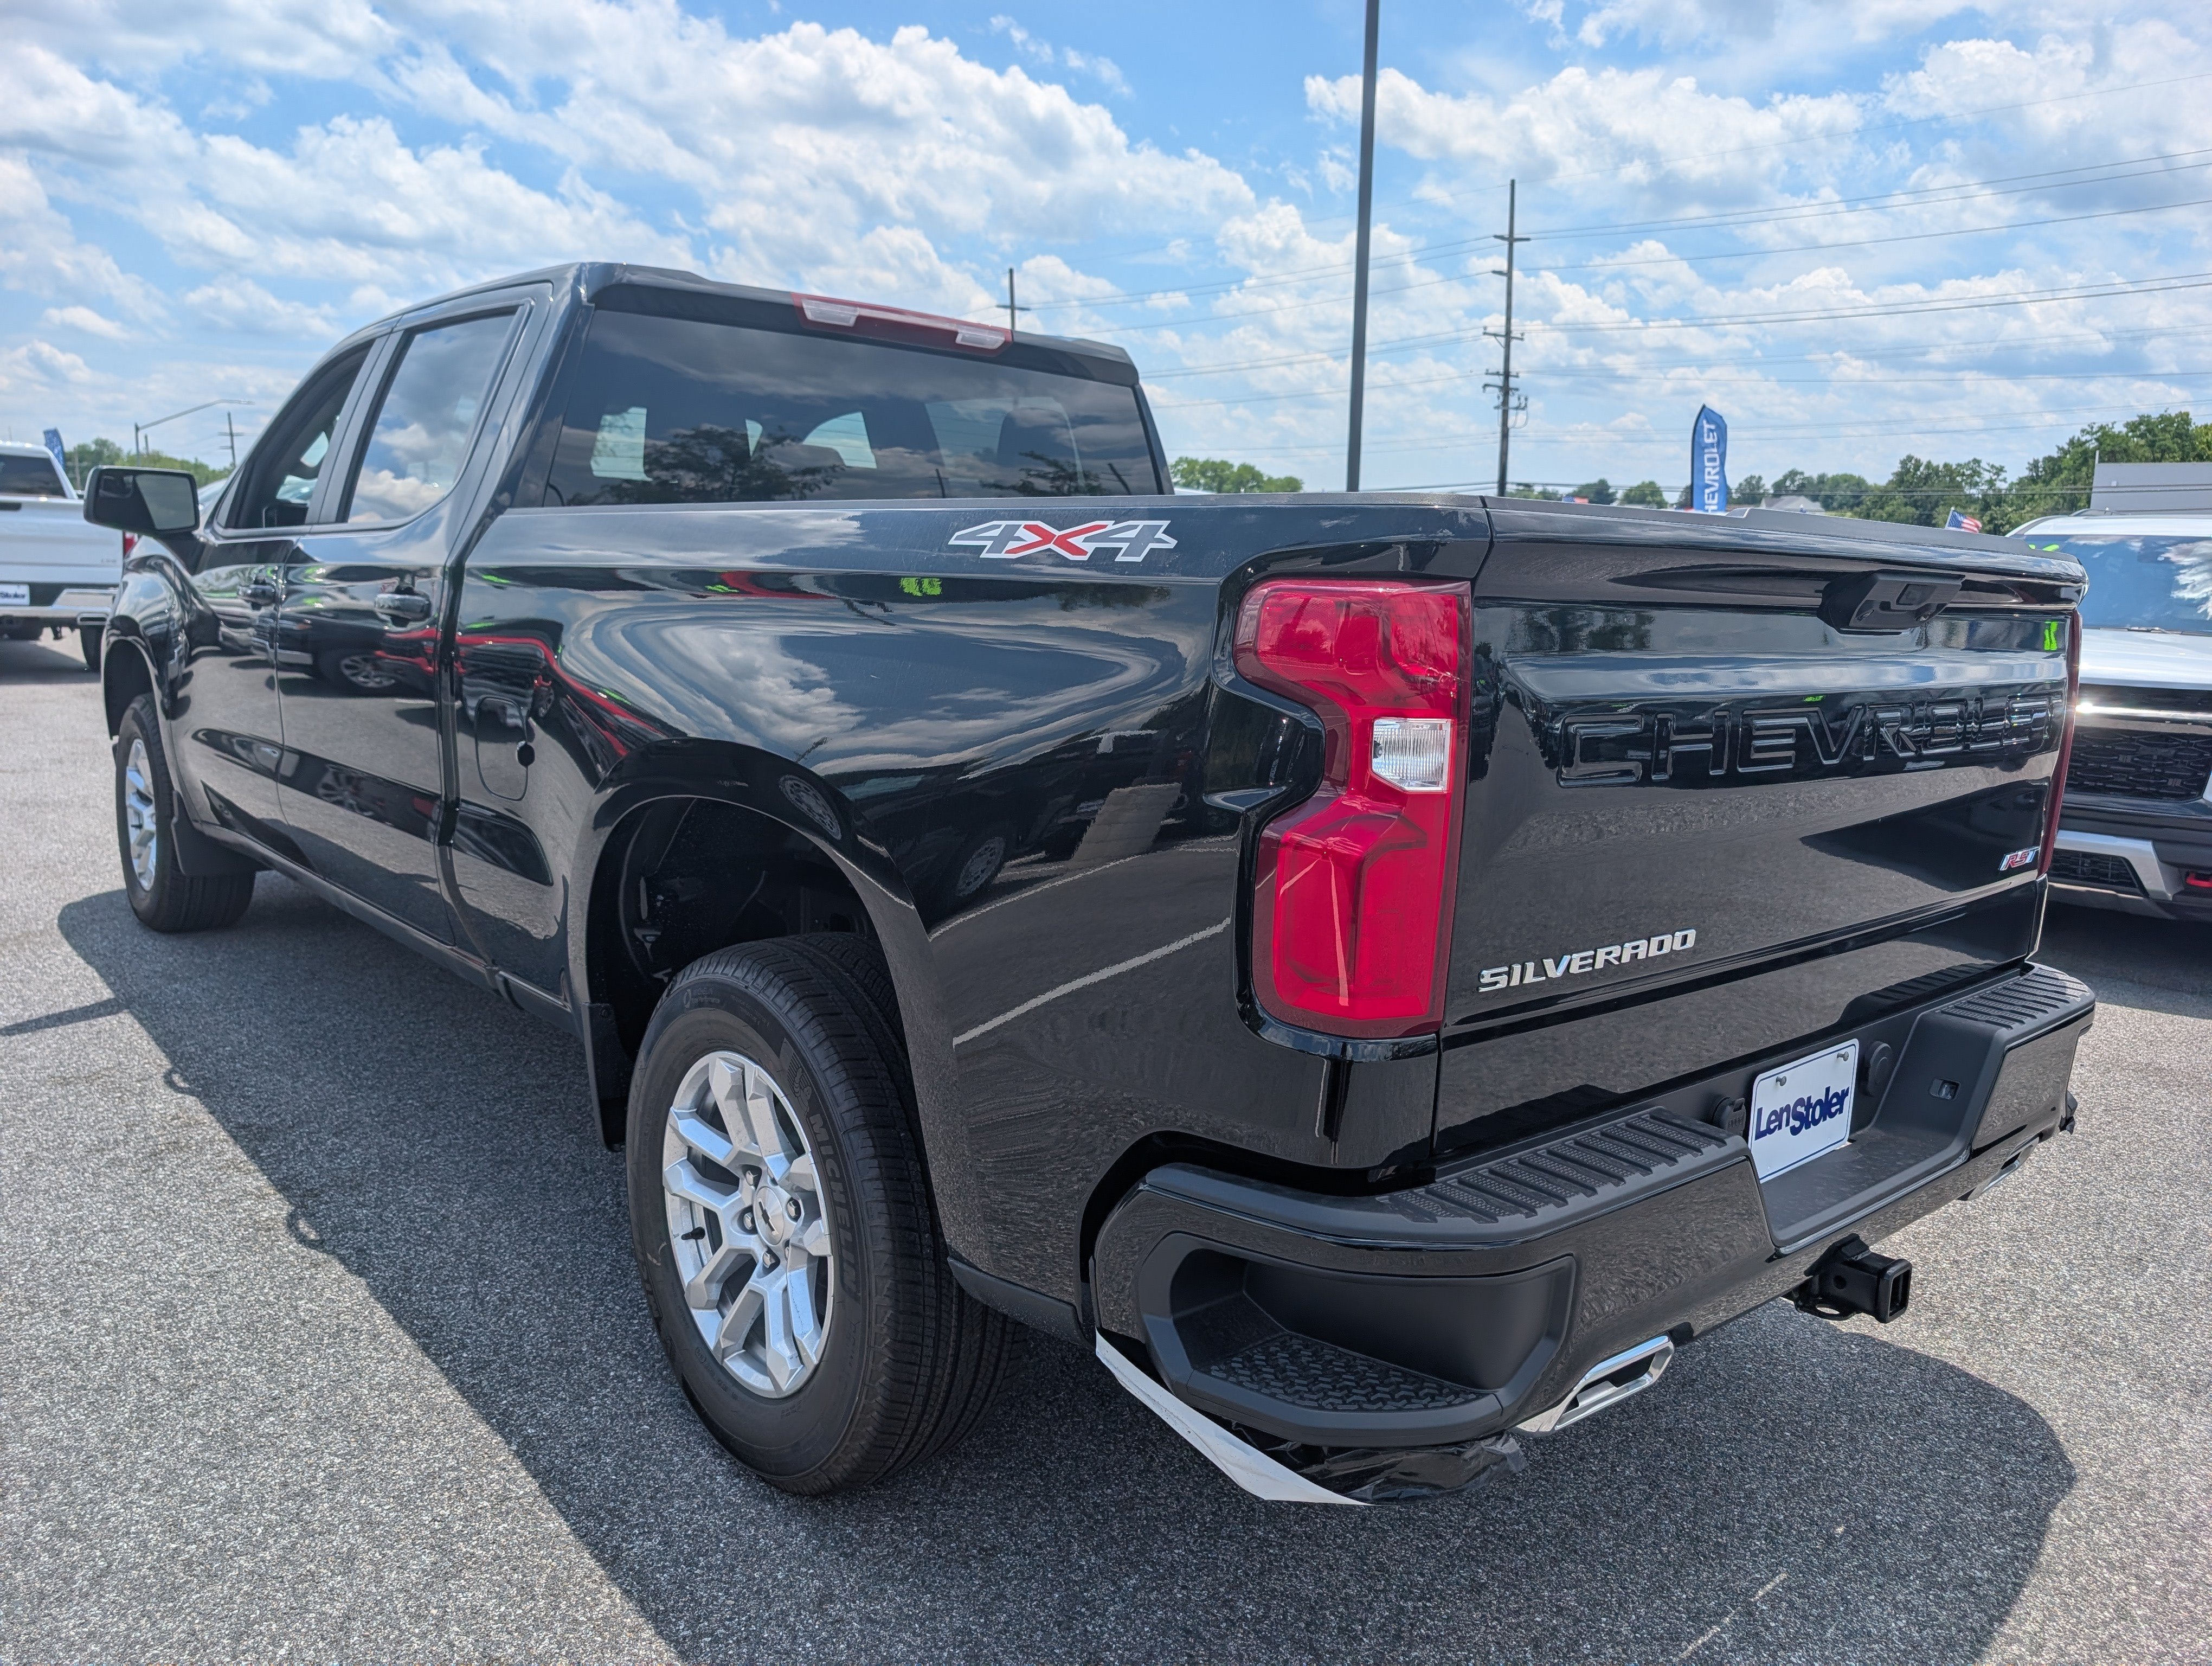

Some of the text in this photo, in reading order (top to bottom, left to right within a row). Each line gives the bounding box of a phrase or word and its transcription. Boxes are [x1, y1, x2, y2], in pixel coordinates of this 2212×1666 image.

[948, 521, 1178, 562] 4X4
[1477, 928, 1696, 992] SILVERADO
[809, 1113, 861, 1294] MICHELIN
